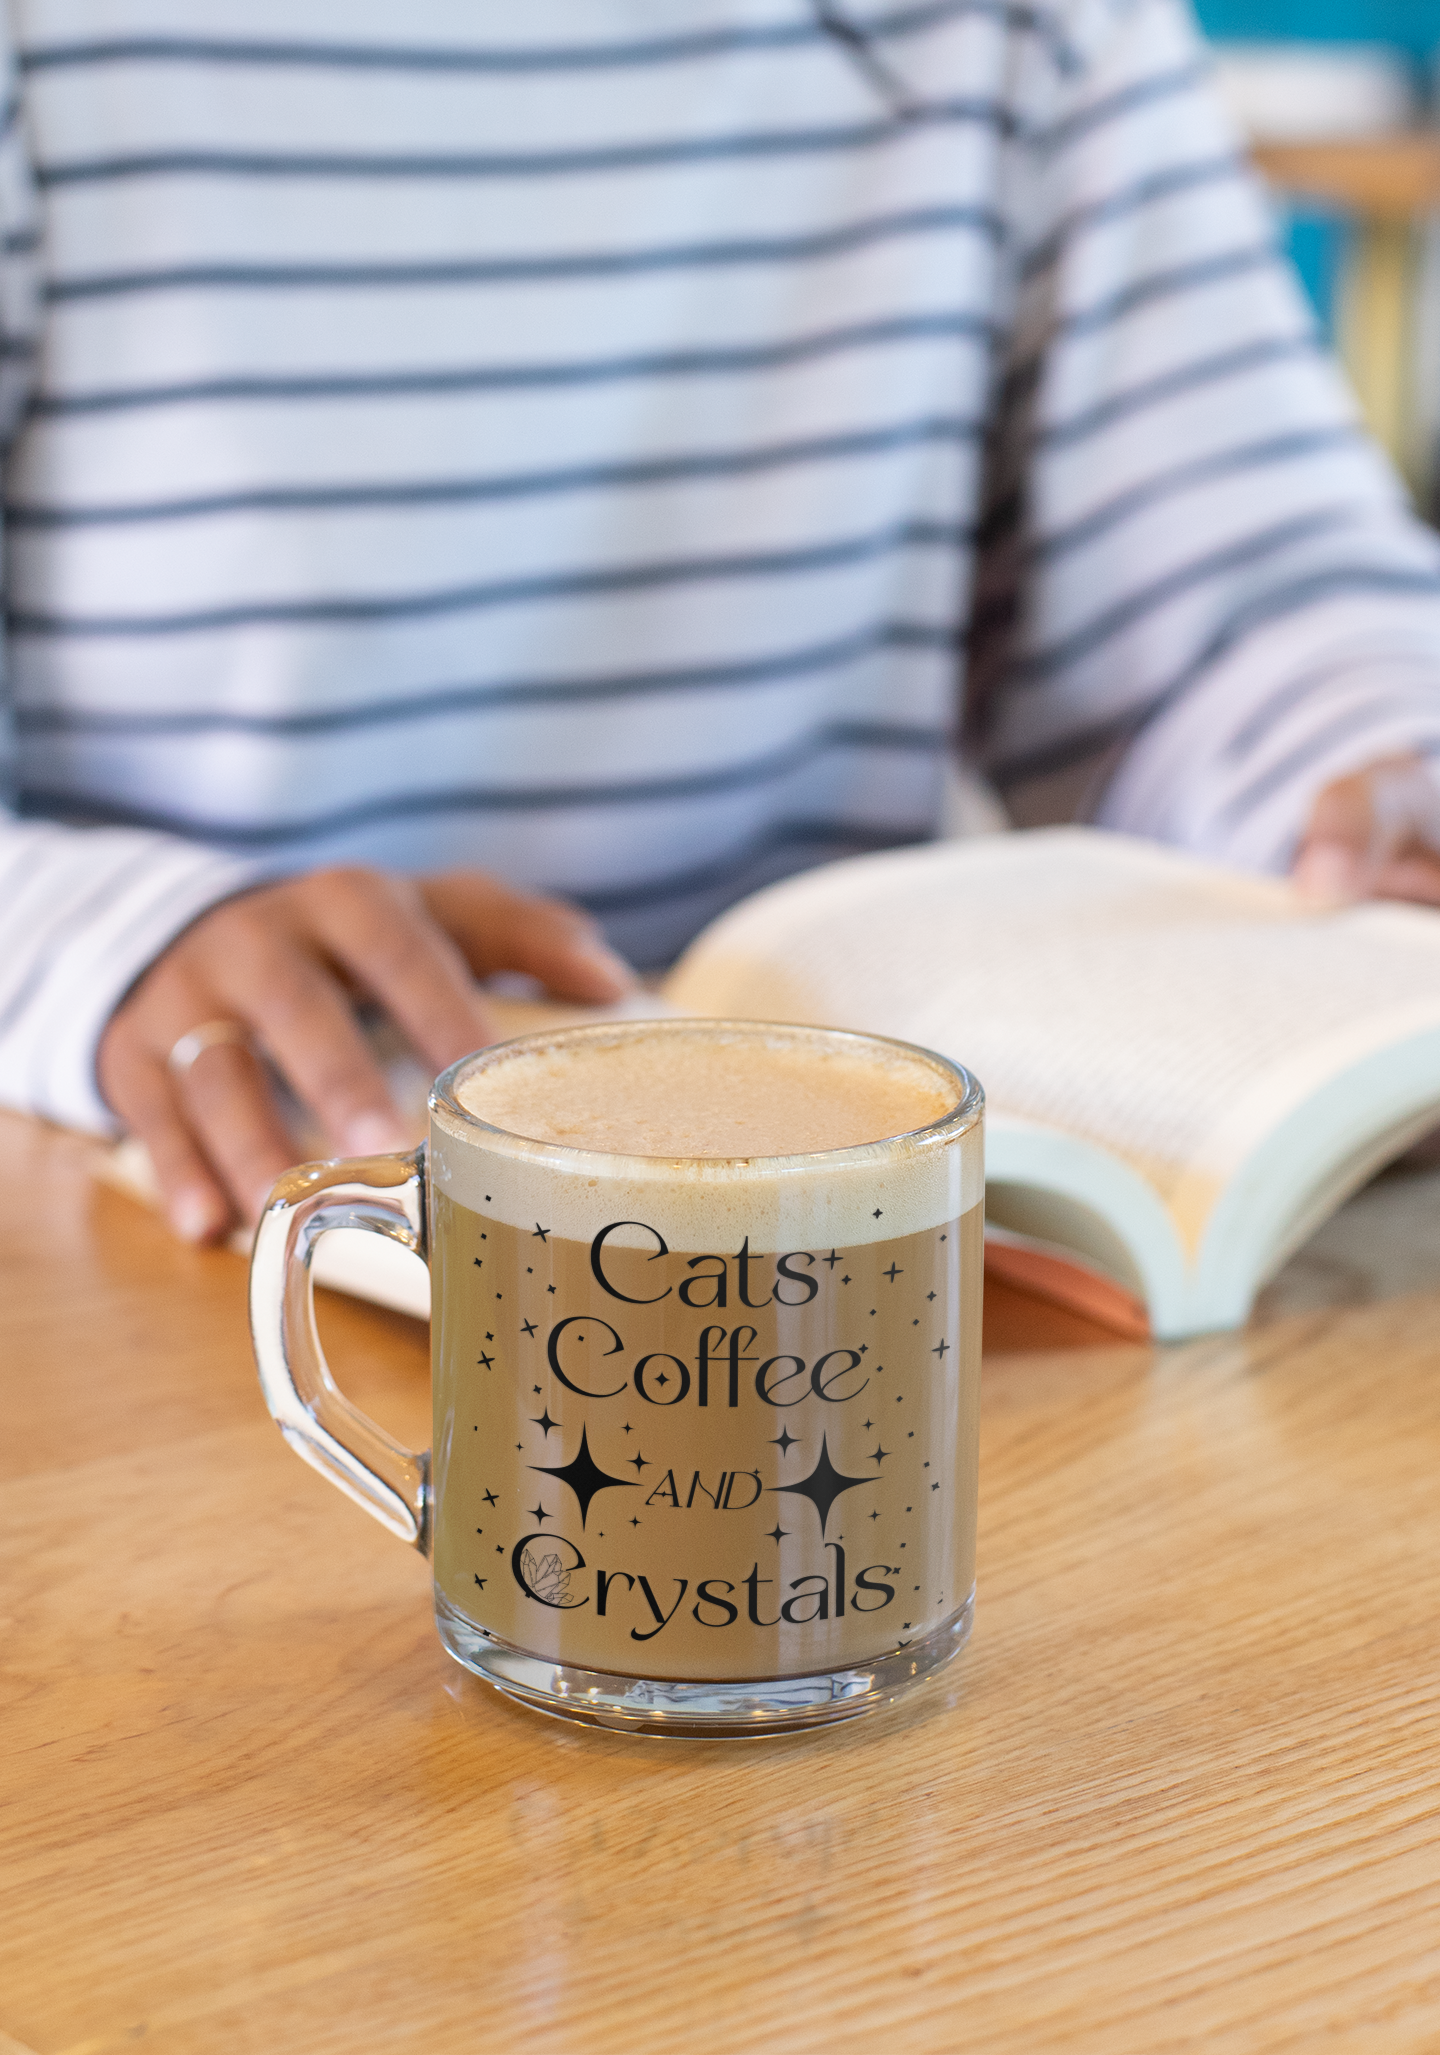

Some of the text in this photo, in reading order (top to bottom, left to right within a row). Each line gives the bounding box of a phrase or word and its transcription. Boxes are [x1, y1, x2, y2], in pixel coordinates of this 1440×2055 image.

[590, 1221, 820, 1308] Cats
[547, 1316, 870, 1407] Coffee
[644, 1468, 764, 1510] AND
[511, 1532, 897, 1641] Crystals
